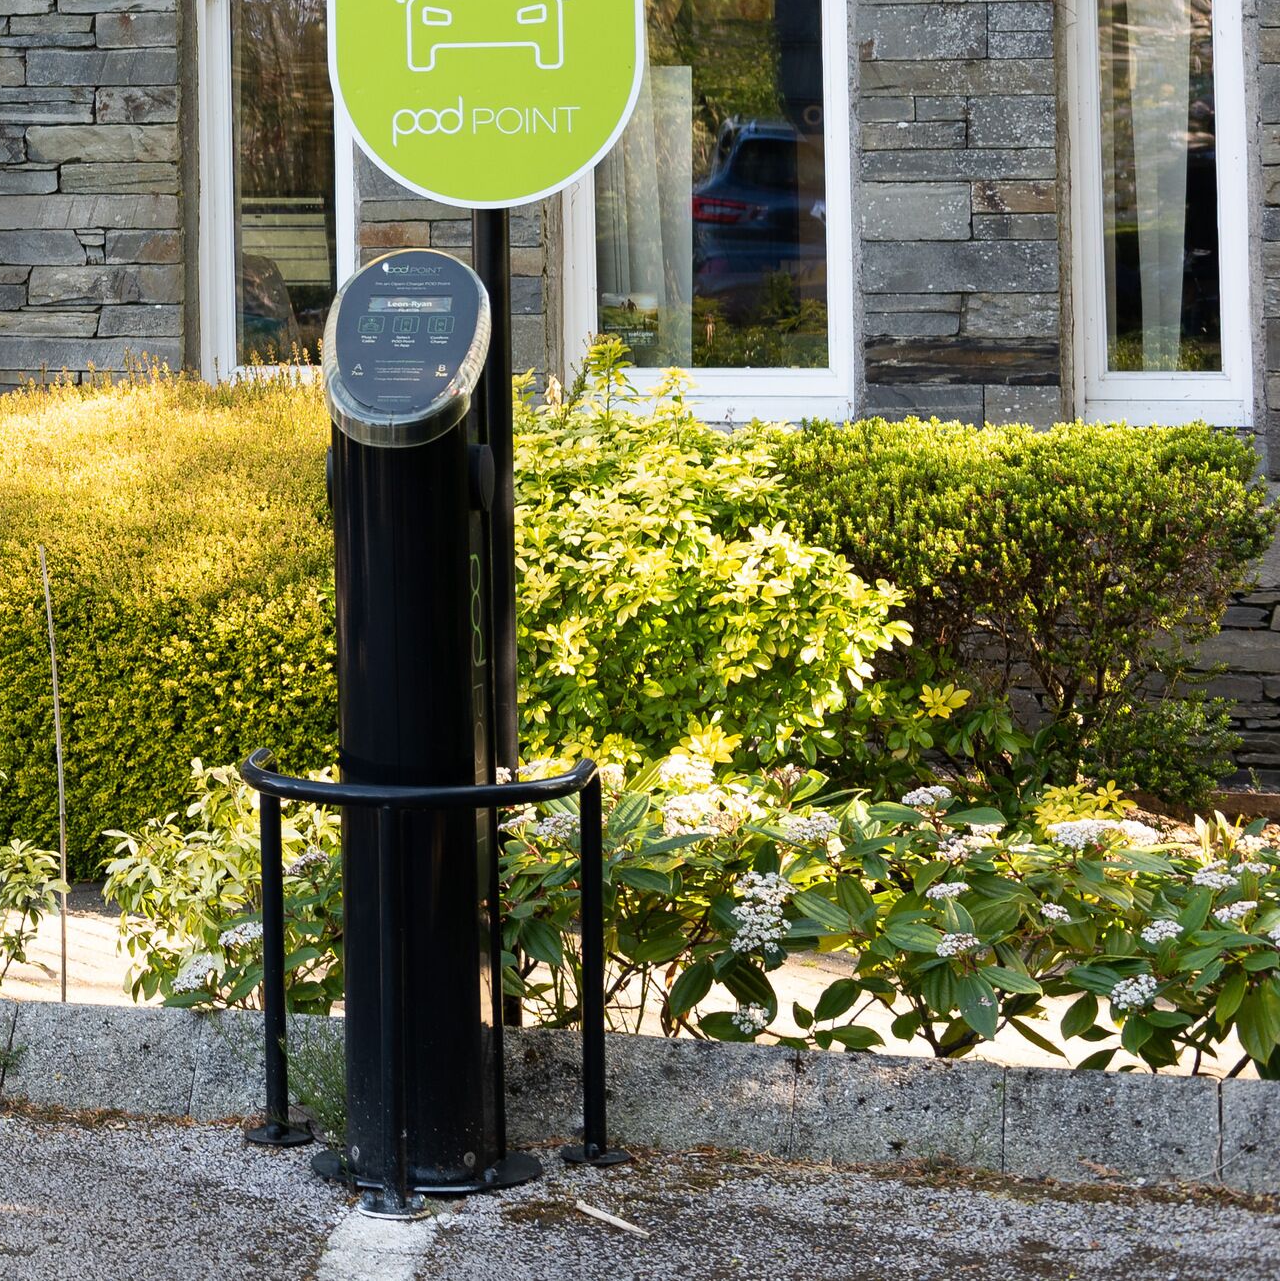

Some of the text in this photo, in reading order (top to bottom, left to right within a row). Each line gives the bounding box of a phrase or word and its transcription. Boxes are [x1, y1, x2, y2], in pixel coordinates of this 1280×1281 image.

[392, 95, 581, 147] pod POINT
[410, 266, 443, 274] POINT
[438, 364, 446, 372] B
[474, 684, 488, 854] POIT
